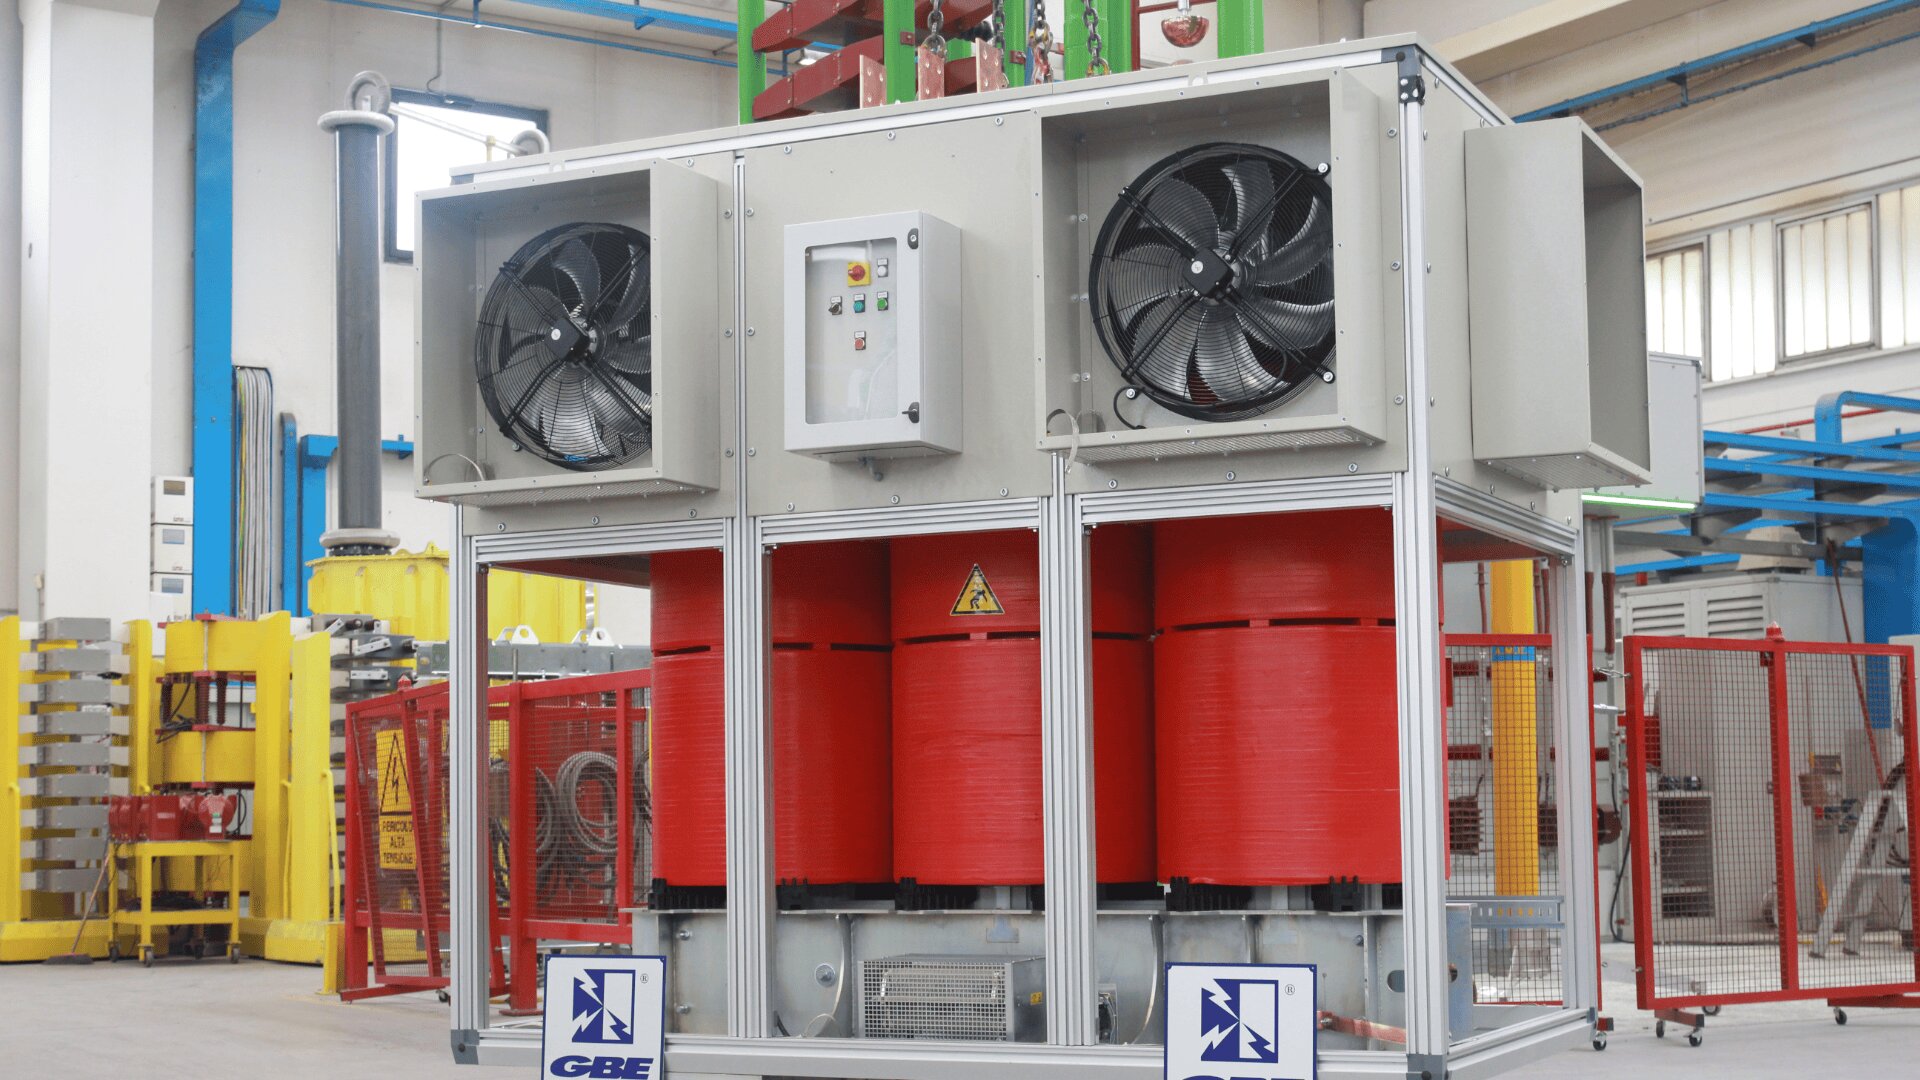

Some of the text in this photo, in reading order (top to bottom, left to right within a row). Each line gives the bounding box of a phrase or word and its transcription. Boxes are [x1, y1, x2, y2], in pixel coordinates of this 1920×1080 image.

[390, 836, 405, 848] ALTA
[383, 852, 413, 864] TENSIONE
[550, 1055, 654, 1080] GBE
